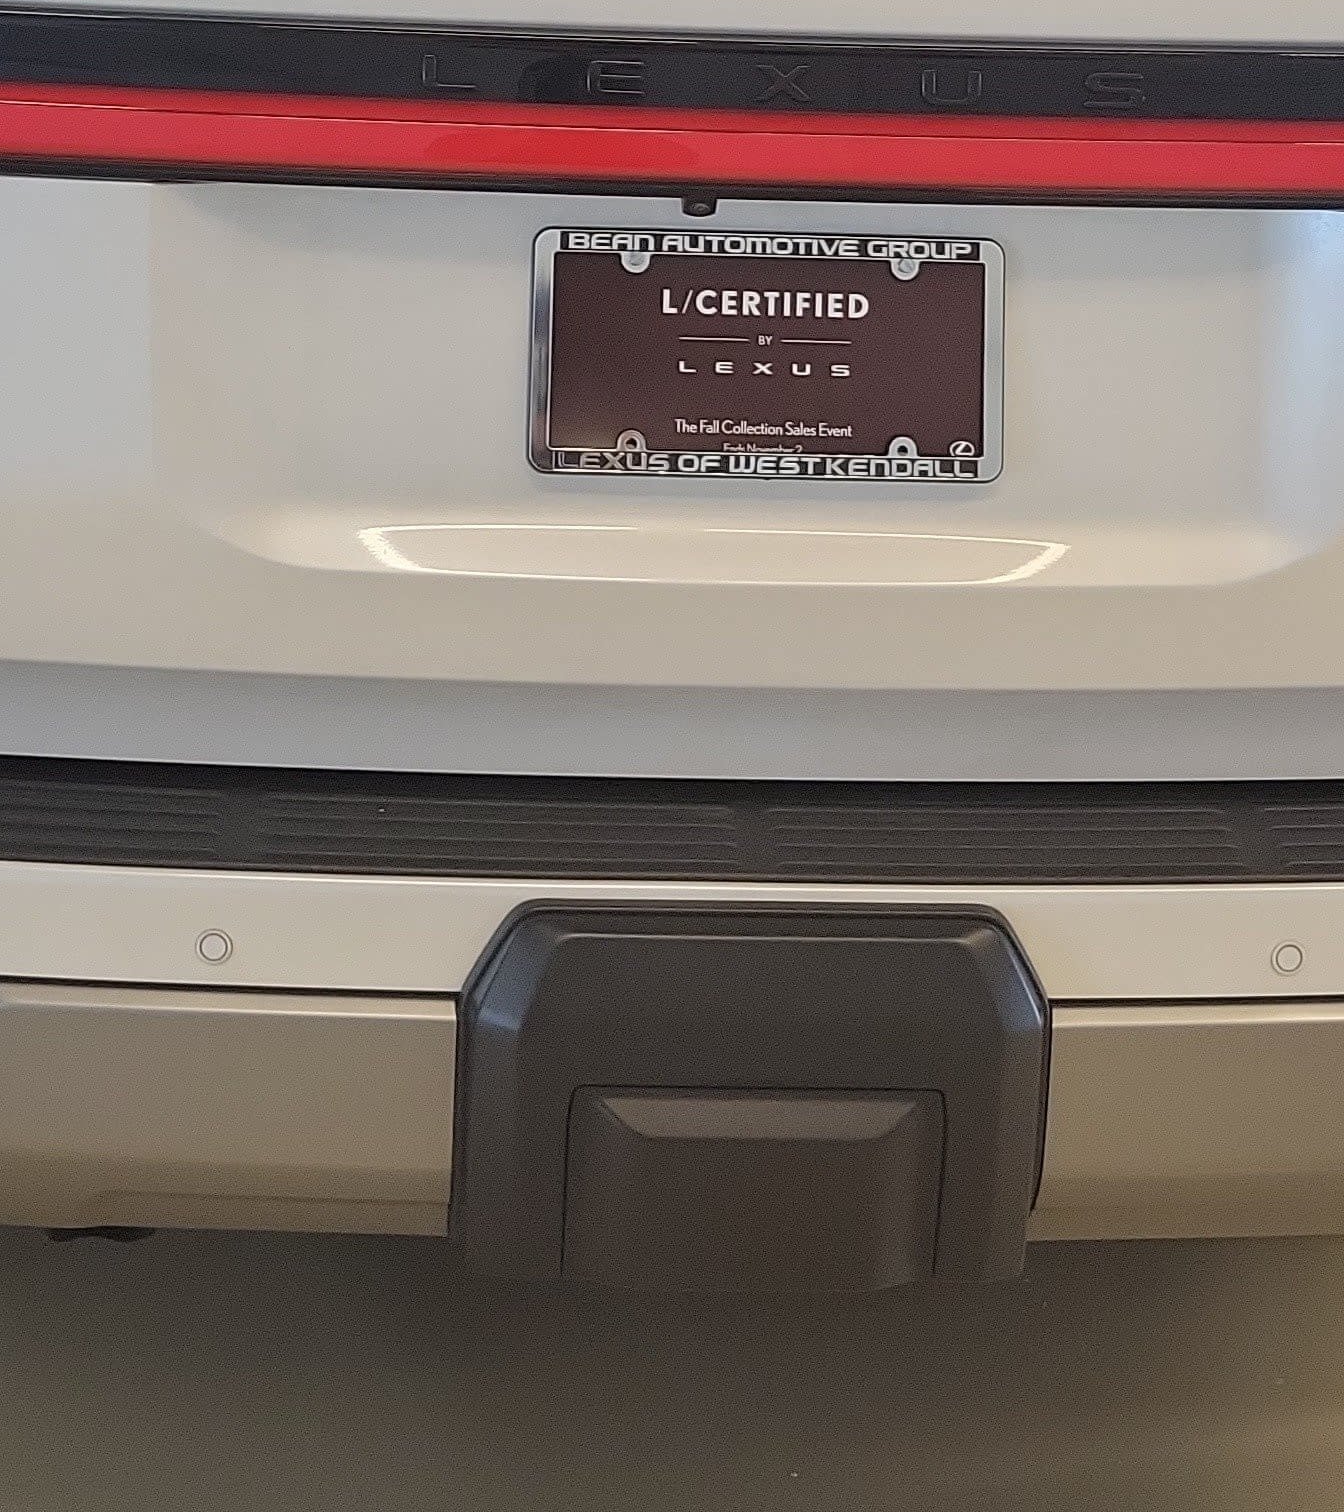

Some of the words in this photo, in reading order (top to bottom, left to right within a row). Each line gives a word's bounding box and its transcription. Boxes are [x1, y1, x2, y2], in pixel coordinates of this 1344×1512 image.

[421, 54, 1148, 108] LEXUS
[567, 232, 655, 251] BEAN
[662, 235, 860, 256] AUTOMOTIVE
[867, 240, 972, 259] GROUP
[662, 288, 870, 319] L/CERTIFIED
[757, 335, 773, 346] BY
[678, 360, 851, 377] LEXUS
[674, 418, 698, 434] The
[699, 419, 720, 434] Fall
[721, 419, 783, 436] Collection
[785, 421, 817, 436] Sales
[818, 422, 853, 437] Event
[557, 451, 670, 471] LEXUS
[677, 454, 723, 473] OF
